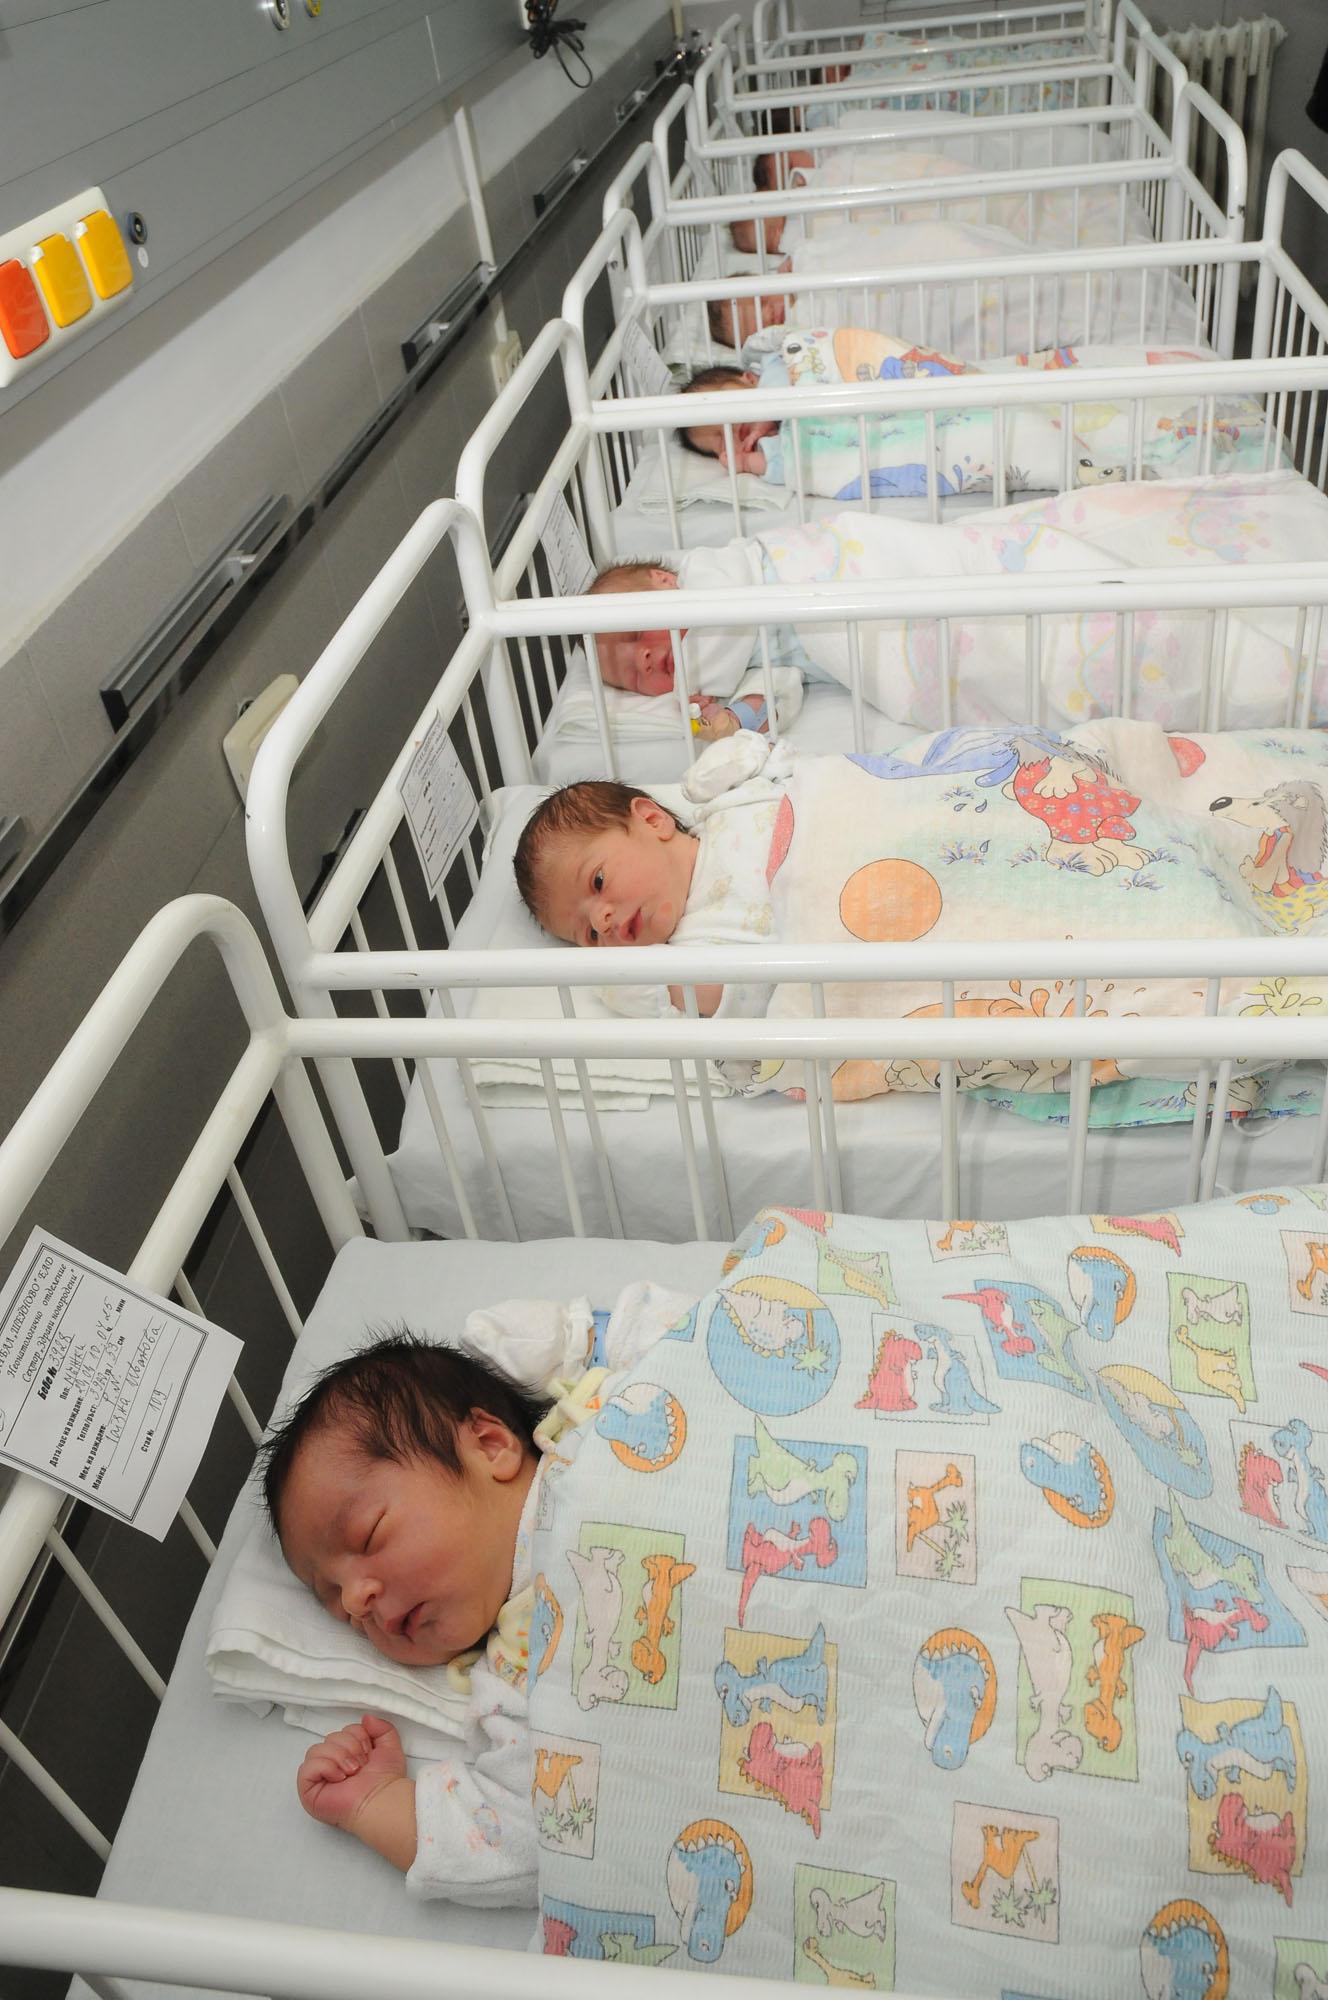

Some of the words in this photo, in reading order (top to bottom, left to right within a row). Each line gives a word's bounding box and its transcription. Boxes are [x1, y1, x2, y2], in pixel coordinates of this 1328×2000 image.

[6, 1310, 43, 1378] Неонатологично
[42, 1263, 67, 1306] отделение
[21, 1350, 43, 1383] Сектор
[36, 1375, 53, 1401] Бебе
[48, 1435, 68, 1468] Дата/час
[62, 1426, 71, 1436] на
[85, 1454, 95, 1465] на
[91, 1466, 107, 1490] Майка:
